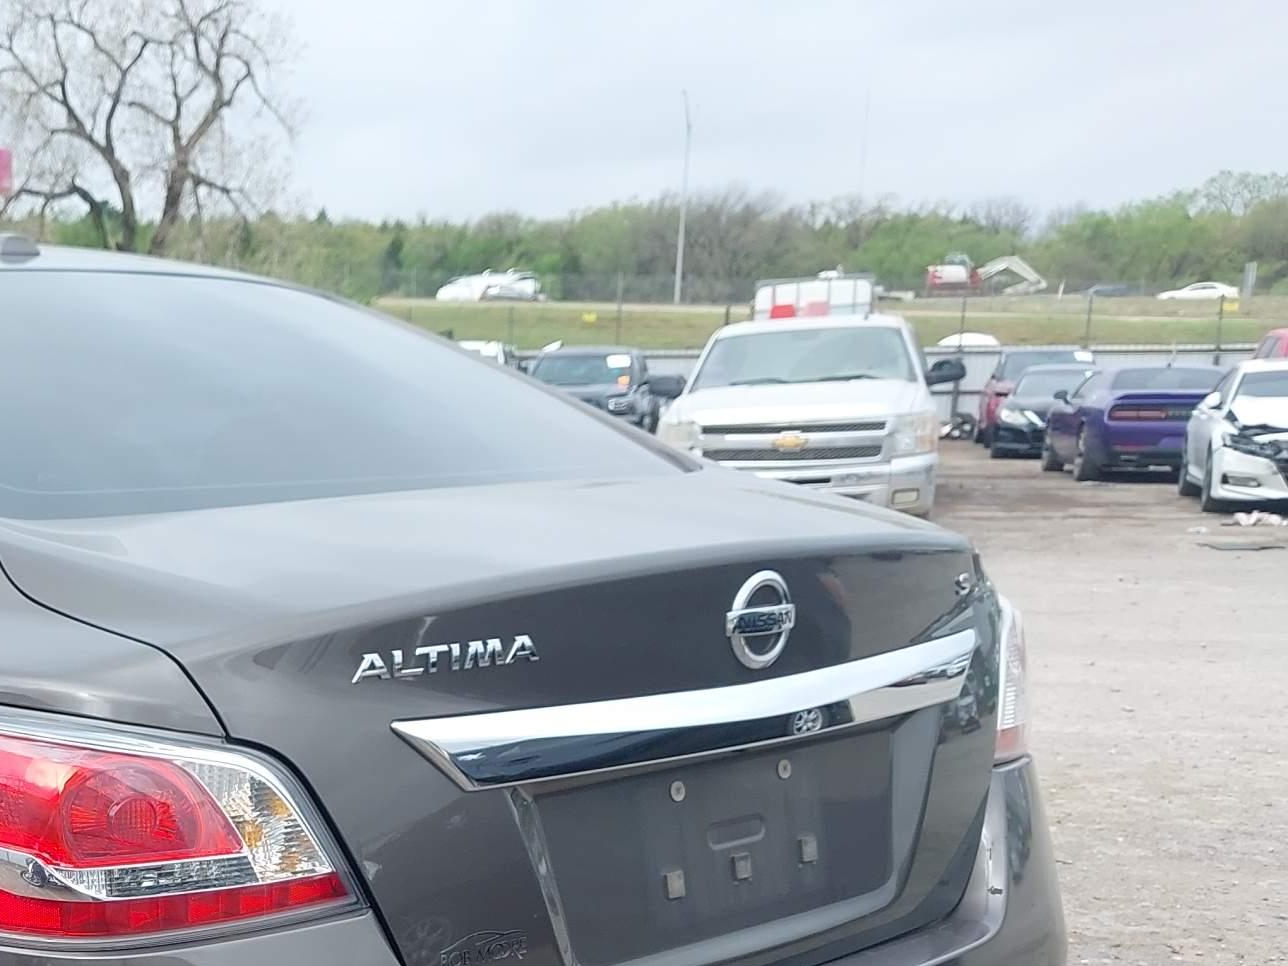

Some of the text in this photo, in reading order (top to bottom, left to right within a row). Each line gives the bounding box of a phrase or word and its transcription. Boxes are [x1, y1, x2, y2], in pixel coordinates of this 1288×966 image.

[732, 609, 793, 634] NISSAN
[351, 634, 540, 684] ALTIMA
[475, 936, 528, 963] MOORE
